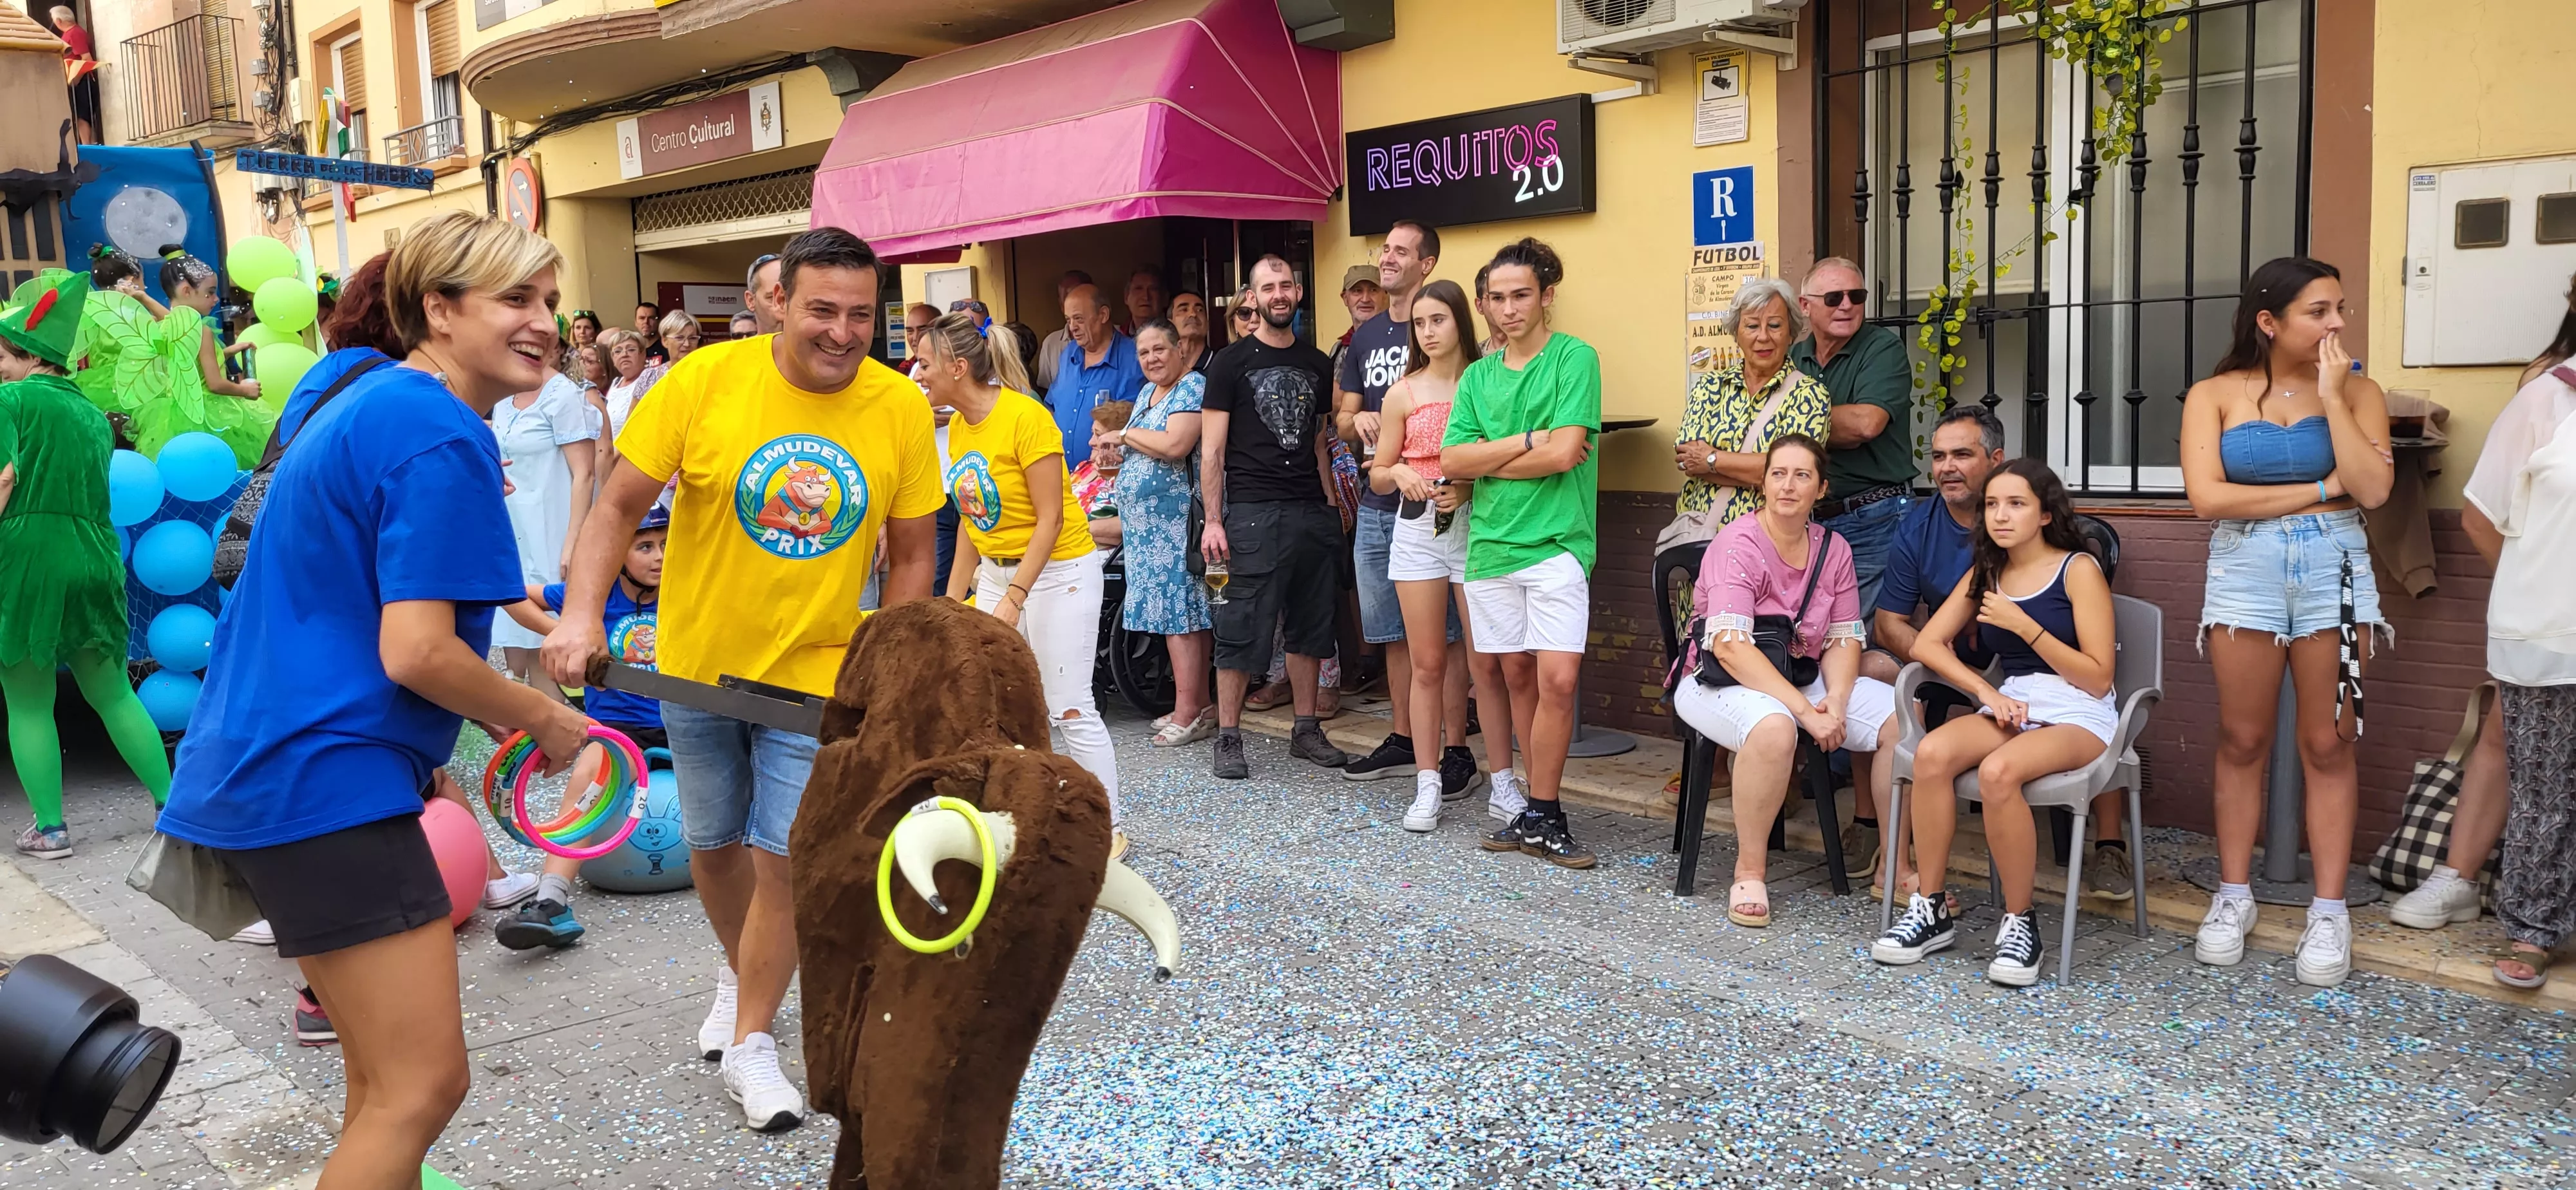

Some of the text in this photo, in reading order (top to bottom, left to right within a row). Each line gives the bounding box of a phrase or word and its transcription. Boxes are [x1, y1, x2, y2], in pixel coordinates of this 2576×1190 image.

[651, 113, 735, 153] Centro Cultural
[240, 151, 316, 175] TIERRA
[1512, 153, 1564, 203] 2.0
[1710, 176, 1738, 218] R
[1694, 245, 1760, 267] FUTBOL
[1714, 310, 1730, 318] BINE
[1692, 325, 1727, 337] A.D. ALMU
[745, 440, 862, 506] ALMUDEVAR
[949, 455, 992, 493] LMUDEVAR
[760, 527, 827, 555] PRIX
[2342, 586, 2353, 607] NIKE
[612, 614, 657, 646] ALMUDE
[2340, 644, 2351, 665] NIKE
[2349, 659, 2360, 678] NIKE
